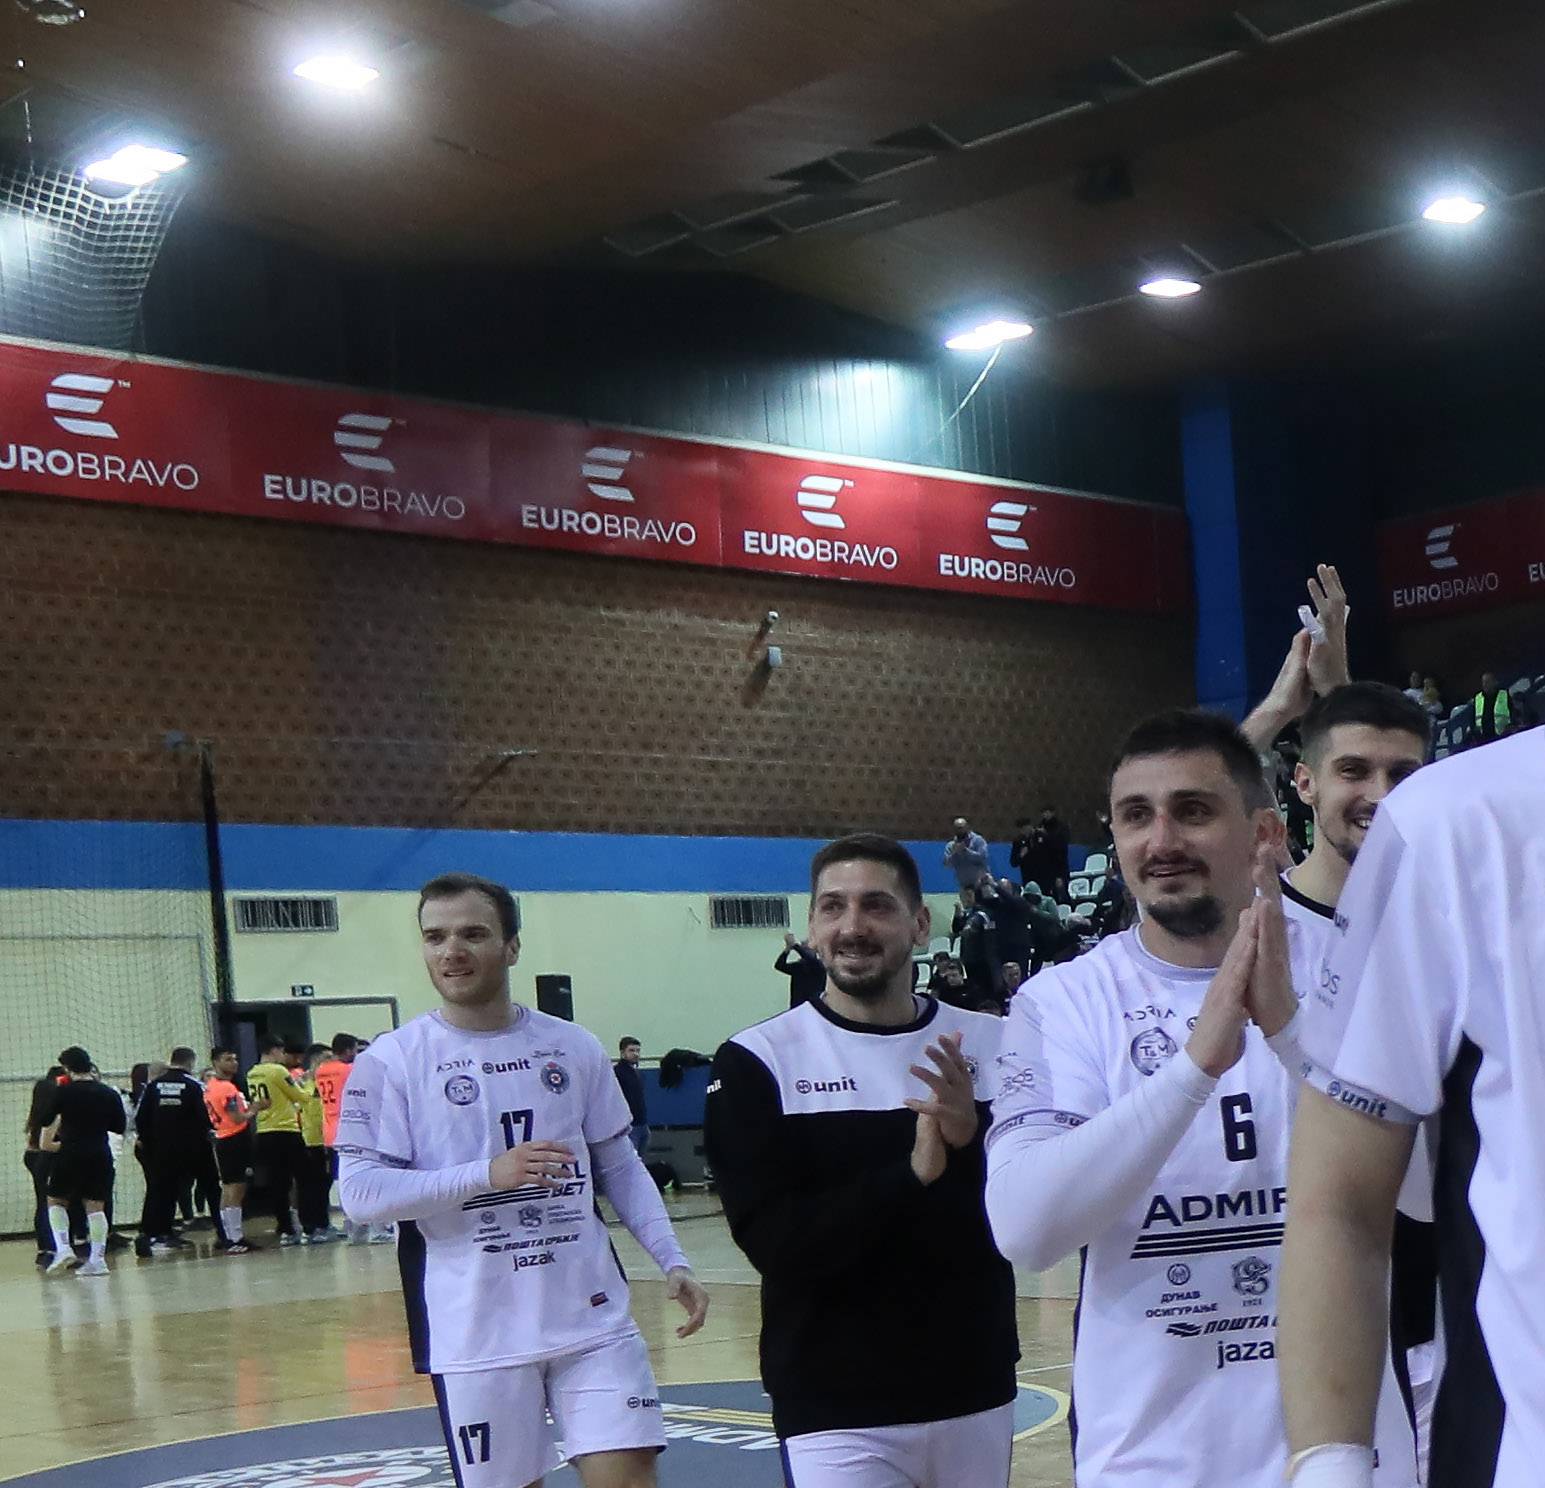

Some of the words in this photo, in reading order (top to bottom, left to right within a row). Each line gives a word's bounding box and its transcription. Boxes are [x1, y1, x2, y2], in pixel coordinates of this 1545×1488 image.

[0, 443, 198, 491] UROBRAVO
[263, 474, 465, 521] EUROBRAVO
[521, 504, 696, 545] EUROBRAVO
[744, 530, 898, 571] EUROBRAVO
[938, 554, 1077, 589] EUROBRAVO
[1393, 572, 1499, 609] EUROBRAVO
[495, 1058, 532, 1073] unit
[706, 1079, 721, 1095] nit
[813, 1076, 858, 1093] unit
[1341, 1087, 1388, 1118] unit
[500, 1109, 534, 1150] 17
[1220, 1092, 1258, 1162] 6
[1141, 1186, 1289, 1230] ADMIR
[513, 1251, 557, 1272] jazak
[1145, 1302, 1219, 1319] ОСИГУРАЊЕ
[1161, 1290, 1201, 1305] ДУНАВ
[1204, 1315, 1269, 1336] ПОШТА
[1217, 1339, 1275, 1370] jaza
[458, 1422, 492, 1465] 17
